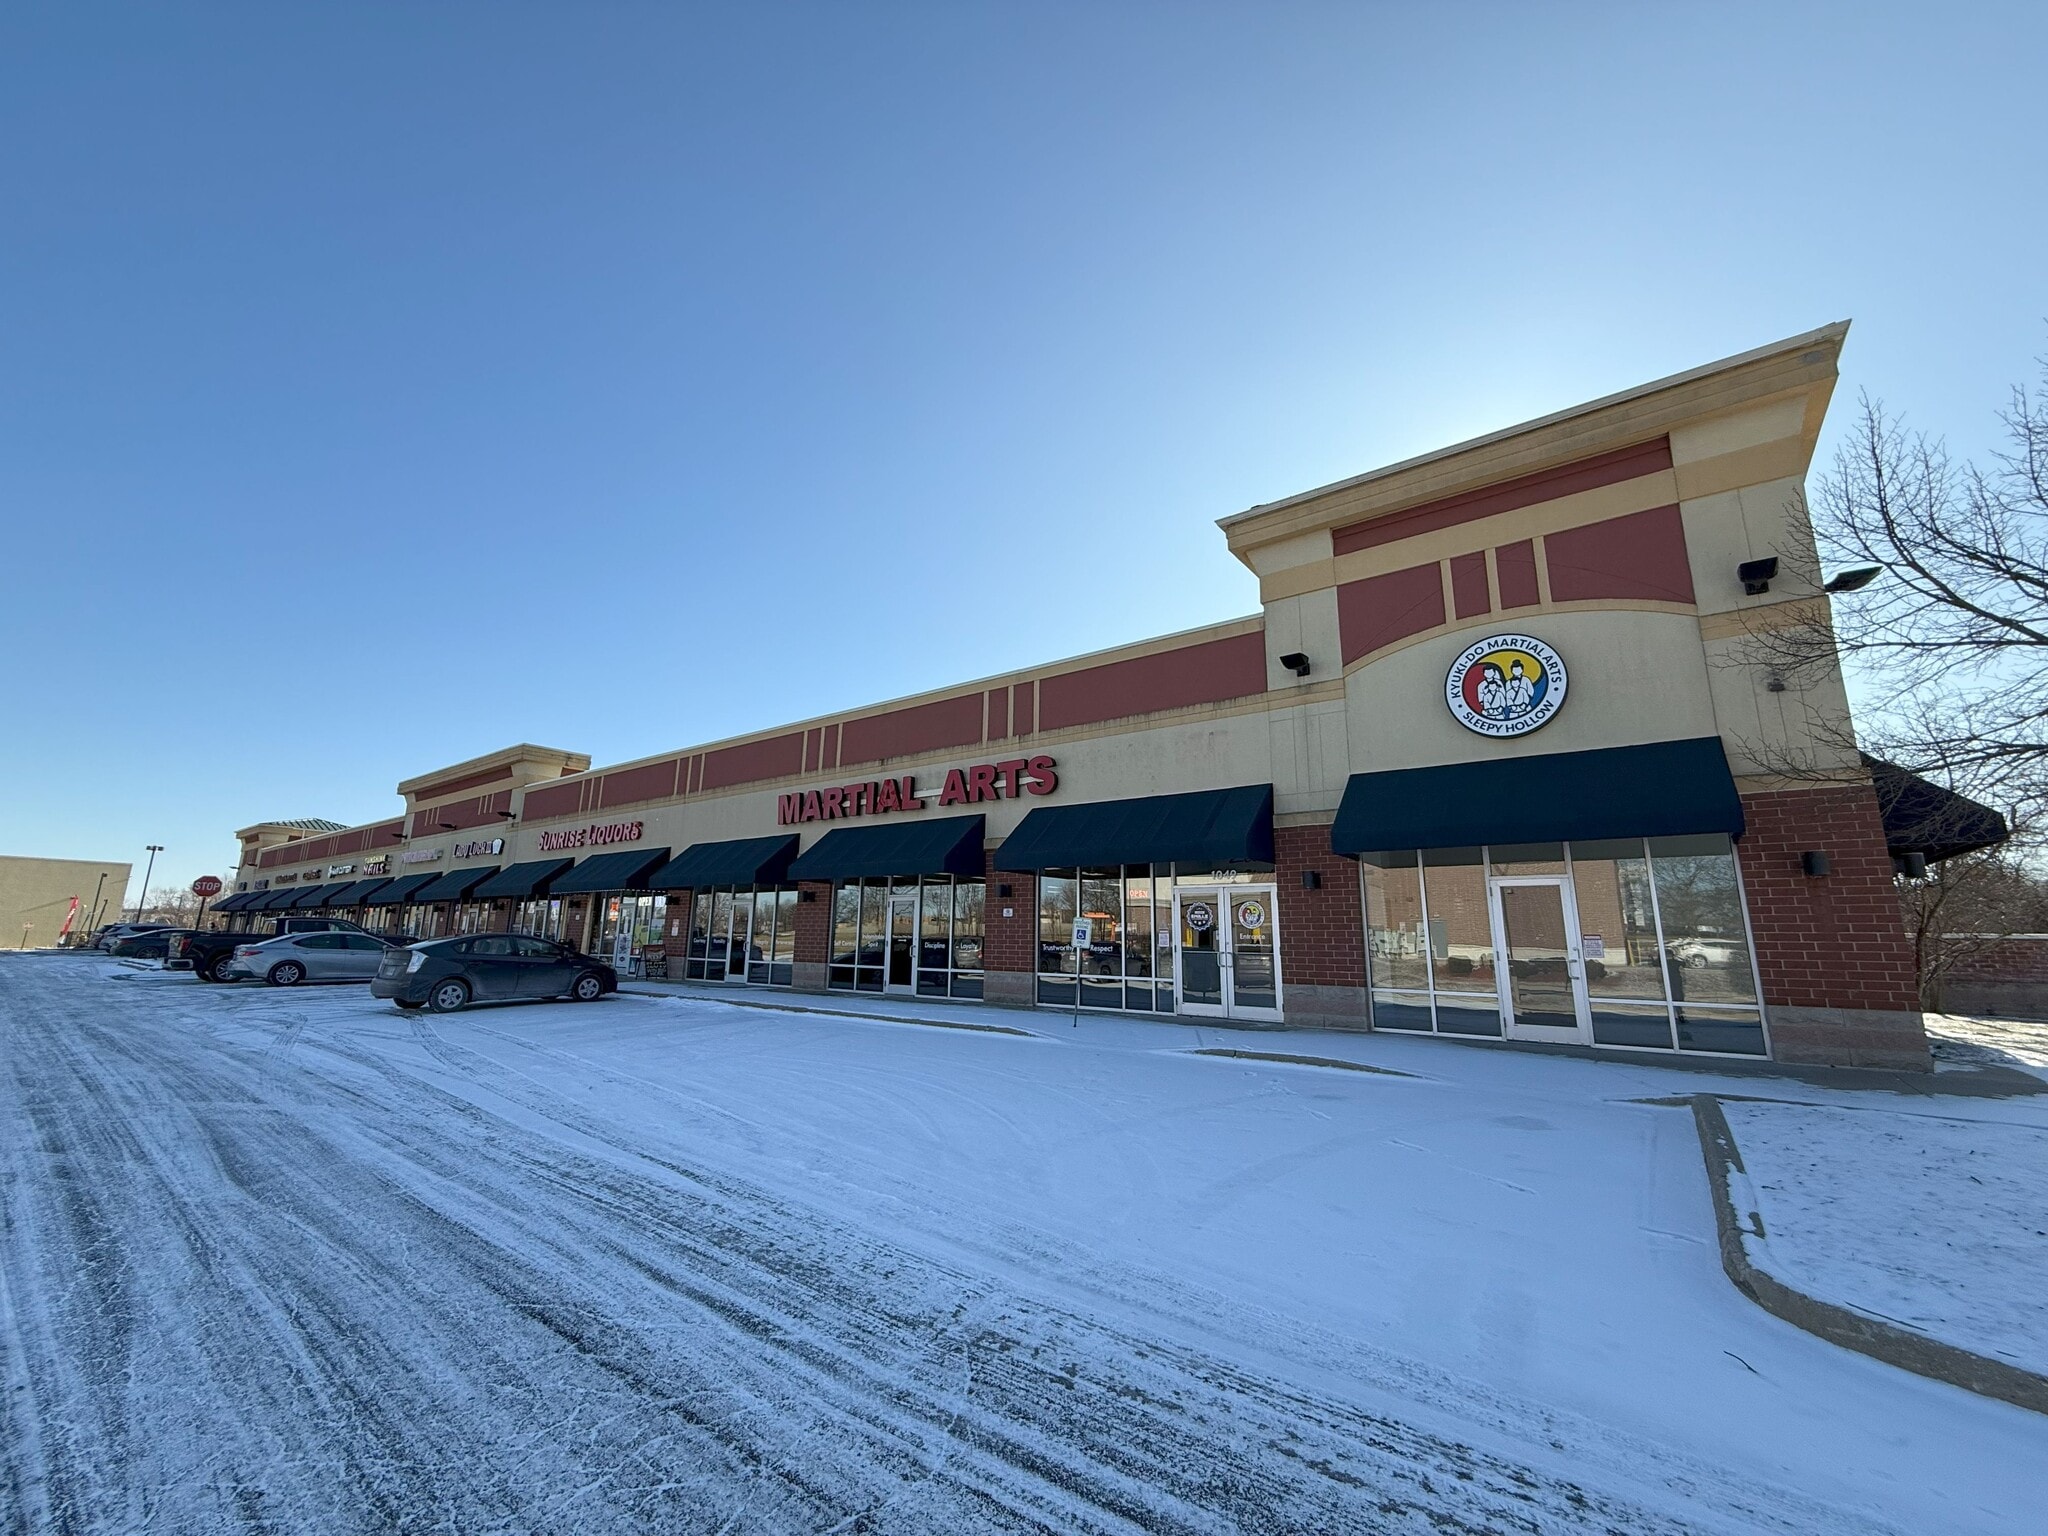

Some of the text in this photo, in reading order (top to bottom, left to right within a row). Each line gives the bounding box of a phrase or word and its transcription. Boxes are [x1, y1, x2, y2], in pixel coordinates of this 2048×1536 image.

[1450, 638, 1562, 699] KYUKI-DO MARTIAL ARTS
[1463, 699, 1555, 733] SLEEPY HOLLOW
[777, 755, 1058, 825] MARTIAL ARTS
[538, 821, 644, 851] SUNRISE LIQUORS
[363, 863, 387, 876] NAILS
[194, 881, 220, 891] STOP
[1130, 889, 1148, 898] OPEN
[1240, 932, 1266, 940] Entrance
[924, 941, 946, 950] Discipline
[960, 942, 978, 951] Loyalty
[1042, 943, 1074, 952] Trustworthy
[1090, 944, 1114, 952] Respect
